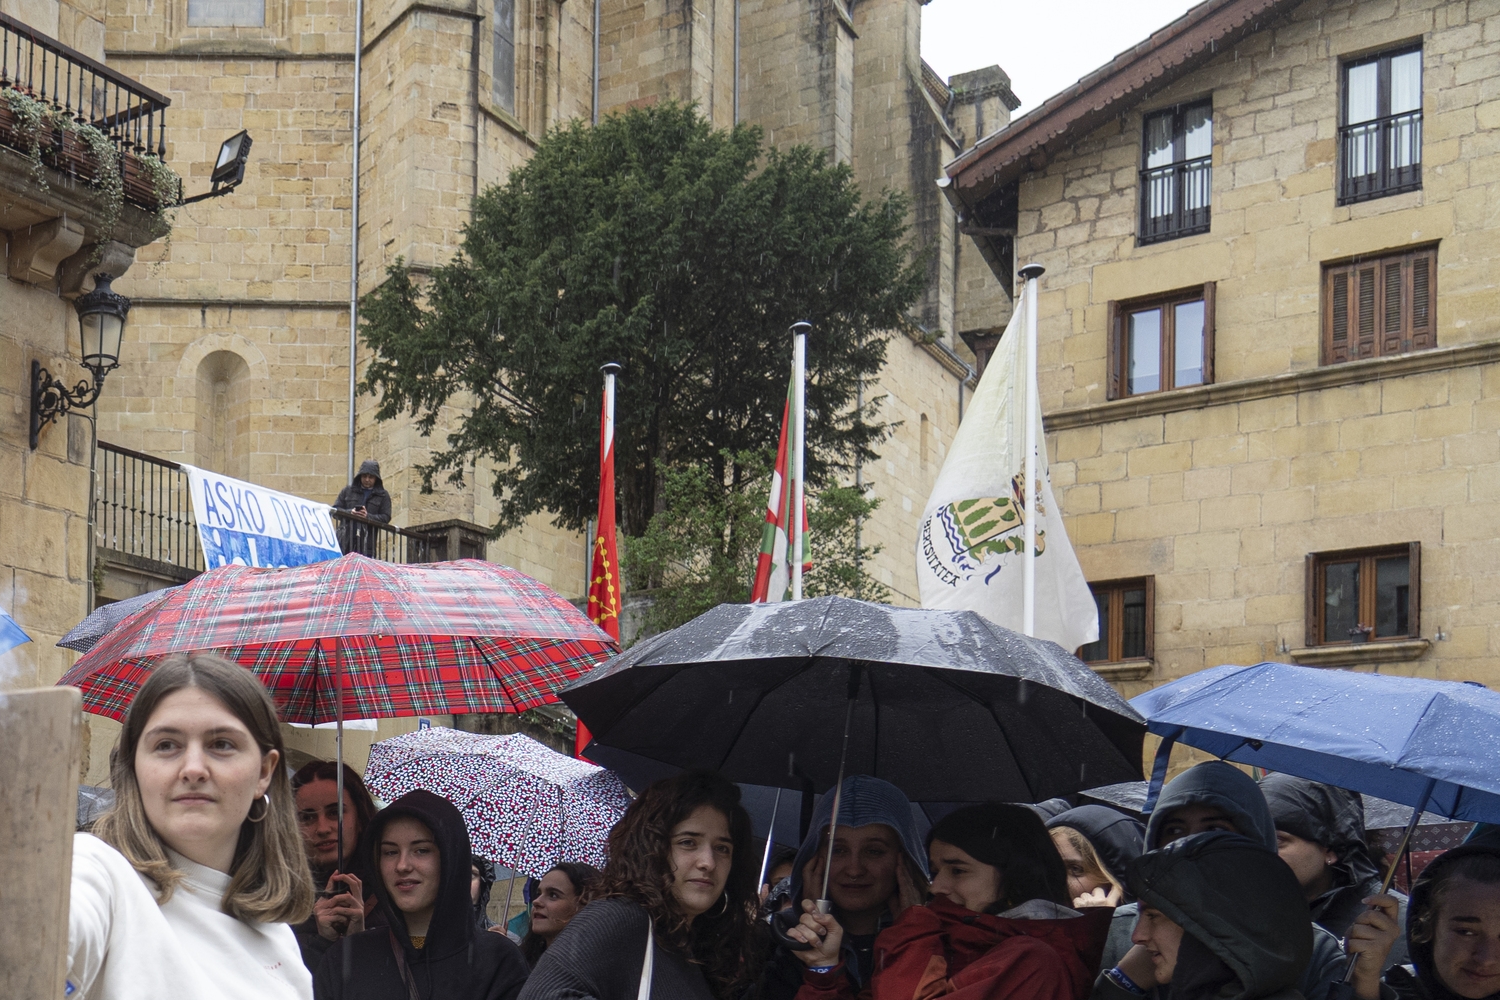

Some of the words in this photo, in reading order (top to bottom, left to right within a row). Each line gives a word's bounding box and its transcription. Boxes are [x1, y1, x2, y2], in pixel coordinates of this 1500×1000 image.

[203, 478, 265, 534] ASKO
[270, 496, 336, 548] DUGU
[923, 515, 960, 587] BERTSITATEA
